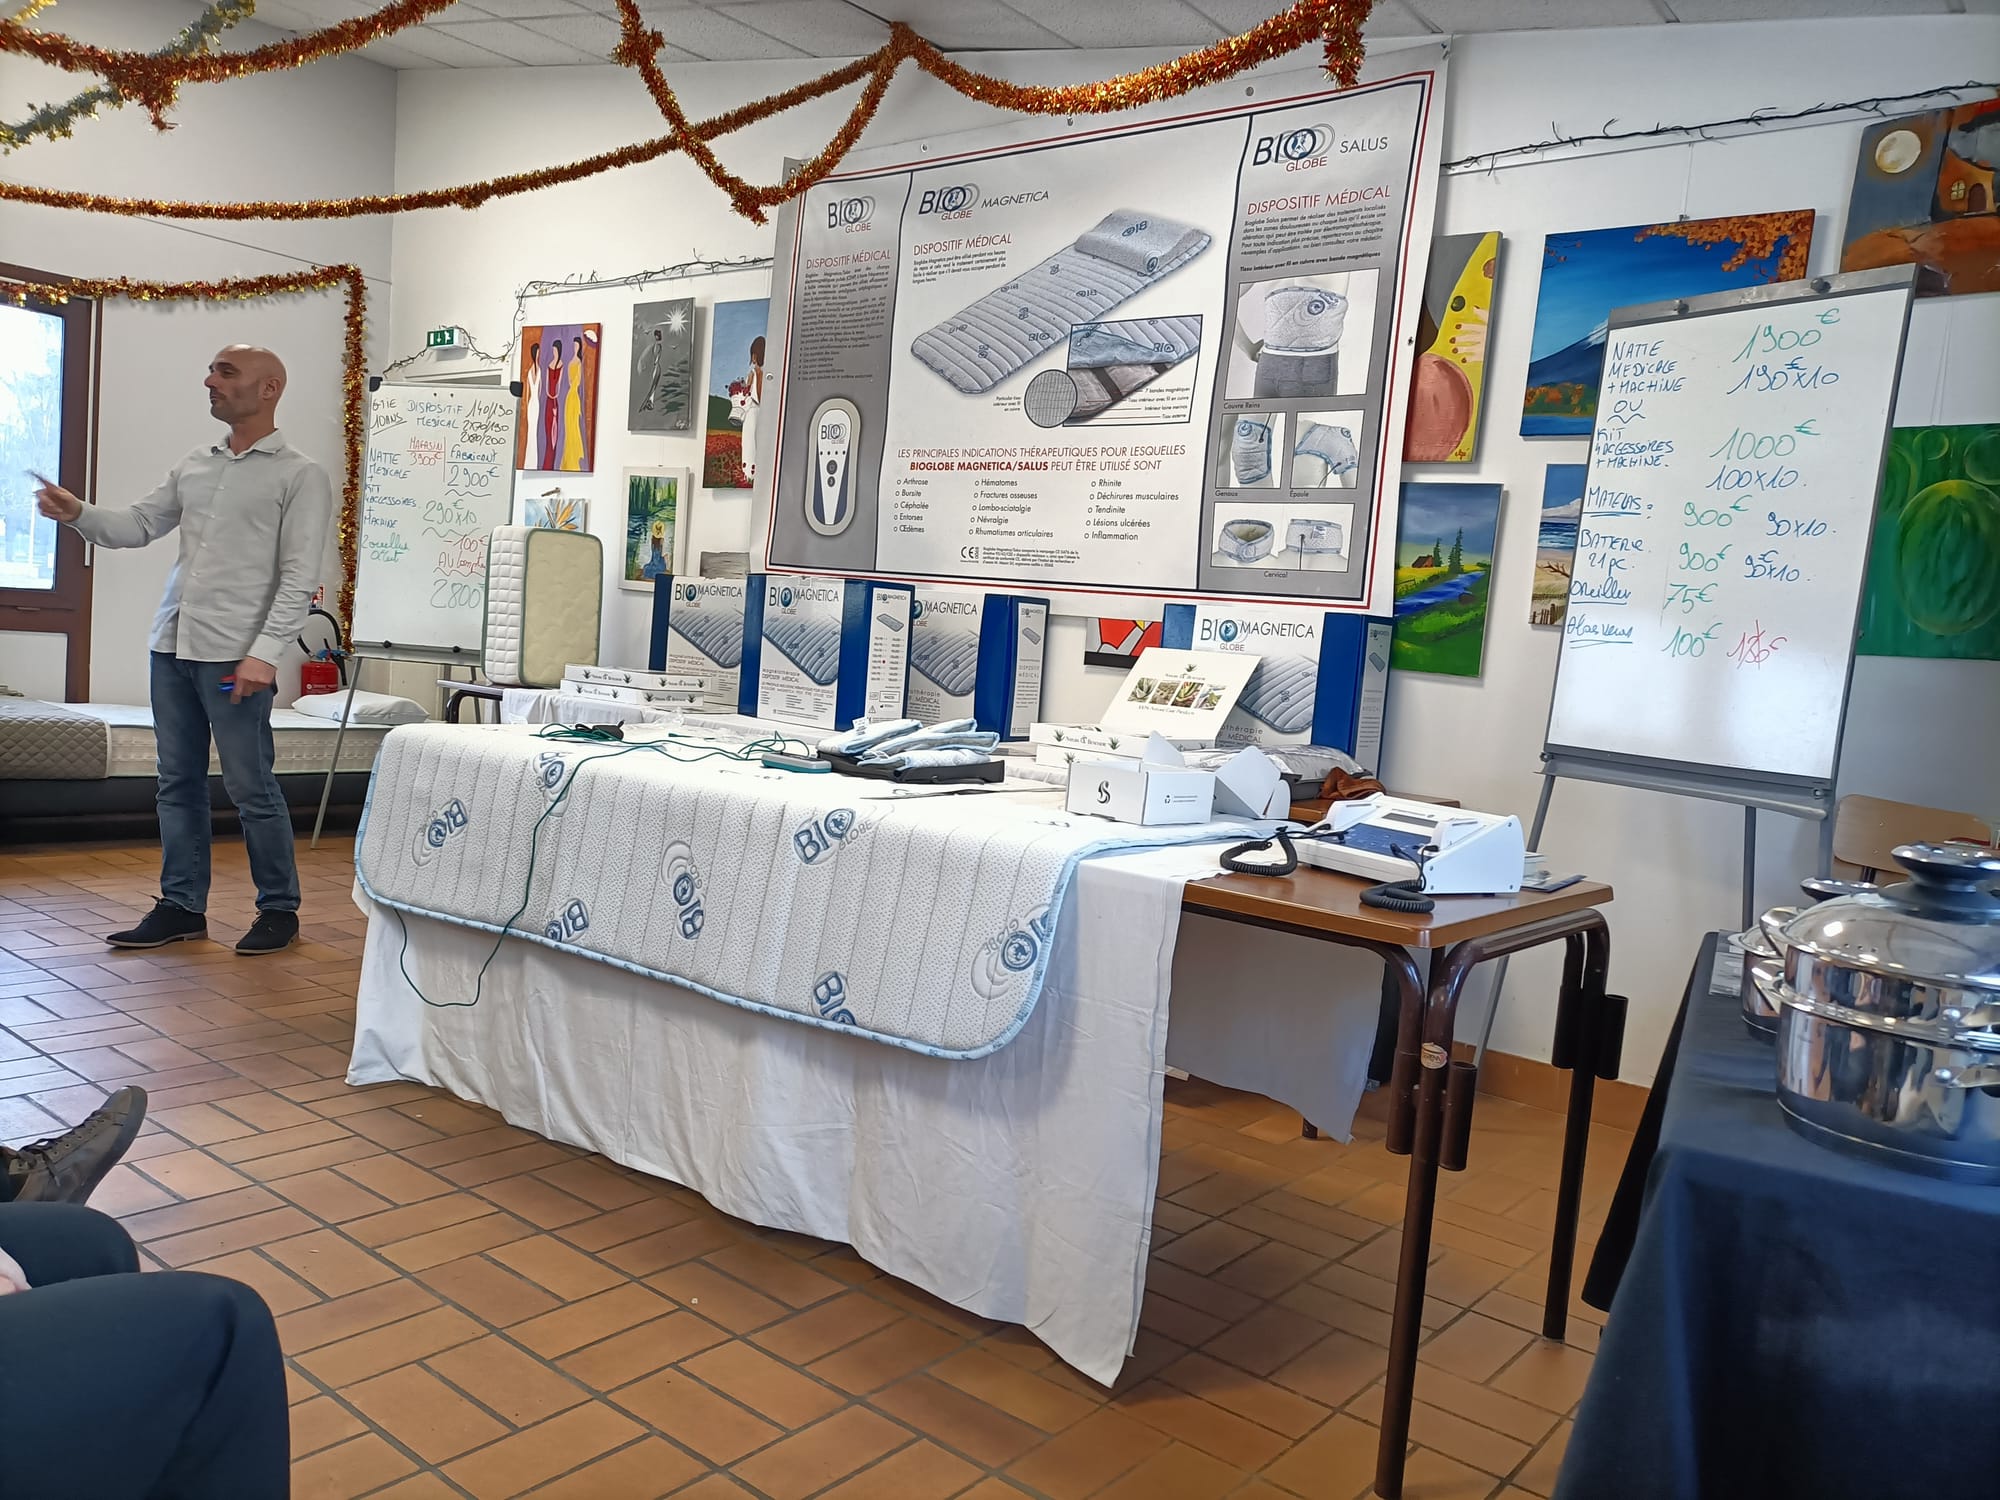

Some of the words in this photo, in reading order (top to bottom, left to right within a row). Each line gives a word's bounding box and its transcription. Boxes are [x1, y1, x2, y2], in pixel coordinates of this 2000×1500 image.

[1340, 137, 1388, 153] SALUS
[1286, 157, 1328, 172] GLOBE
[981, 191, 1049, 208] MAGNETICA
[1248, 195, 1320, 215] DISPOSITIF
[1325, 185, 1390, 206] MÉDICAL
[941, 210, 973, 220] GLOBE
[845, 223, 871, 233] GLOBE
[914, 239, 963, 255] DISPOSITIF
[966, 233, 1012, 248] MÉDICAL
[806, 256, 850, 269] DISPOSITIF
[852, 250, 891, 264] MÉDICAL
[1613, 340, 1664, 360] NATTE
[369, 448, 400, 464] NATTE
[898, 449, 911, 458] LES
[912, 448, 960, 458] PRINCIPALES
[962, 447, 1017, 457] INDICATIONS
[1020, 445, 1098, 457] THÉRAPEUTIQUES
[1100, 447, 1128, 457] POUR
[1130, 445, 1185, 457] LESQUELLES
[910, 461, 954, 471] BIOGLOBE
[957, 461, 1048, 471] MAGNETICA/SALUS
[1051, 461, 1073, 471] PEUT
[1076, 459, 1097, 471] ÊTRE
[1100, 458, 1131, 471] UTILISÉ
[1133, 460, 1162, 471] SONT
[903, 478, 928, 486] Arthrose
[981, 479, 1018, 487] Hématomes
[1098, 479, 1122, 487] Rhinite
[902, 489, 921, 497] Bursite
[980, 491, 1008, 499] Fractures
[1097, 492, 1133, 501] Déchirures
[1135, 492, 1179, 501] musculaires
[900, 501, 929, 511] Céphalée
[1095, 505, 1125, 514] Tendinite
[977, 516, 1008, 525] Névralgie
[1093, 518, 1118, 527] Lésions
[1120, 519, 1150, 528] ulcérées
[975, 528, 1015, 537] Rhumatismes
[1017, 529, 1053, 538] articulaires
[1092, 532, 1138, 541] Inflammation
[698, 586, 743, 598] MAGNETICA
[793, 588, 839, 602] MAGNETICA
[924, 602, 977, 615] MAGNETICA
[1240, 621, 1314, 638] MAGNETICA
[1220, 643, 1244, 651] GLOBE
[794, 808, 856, 864] BIO
